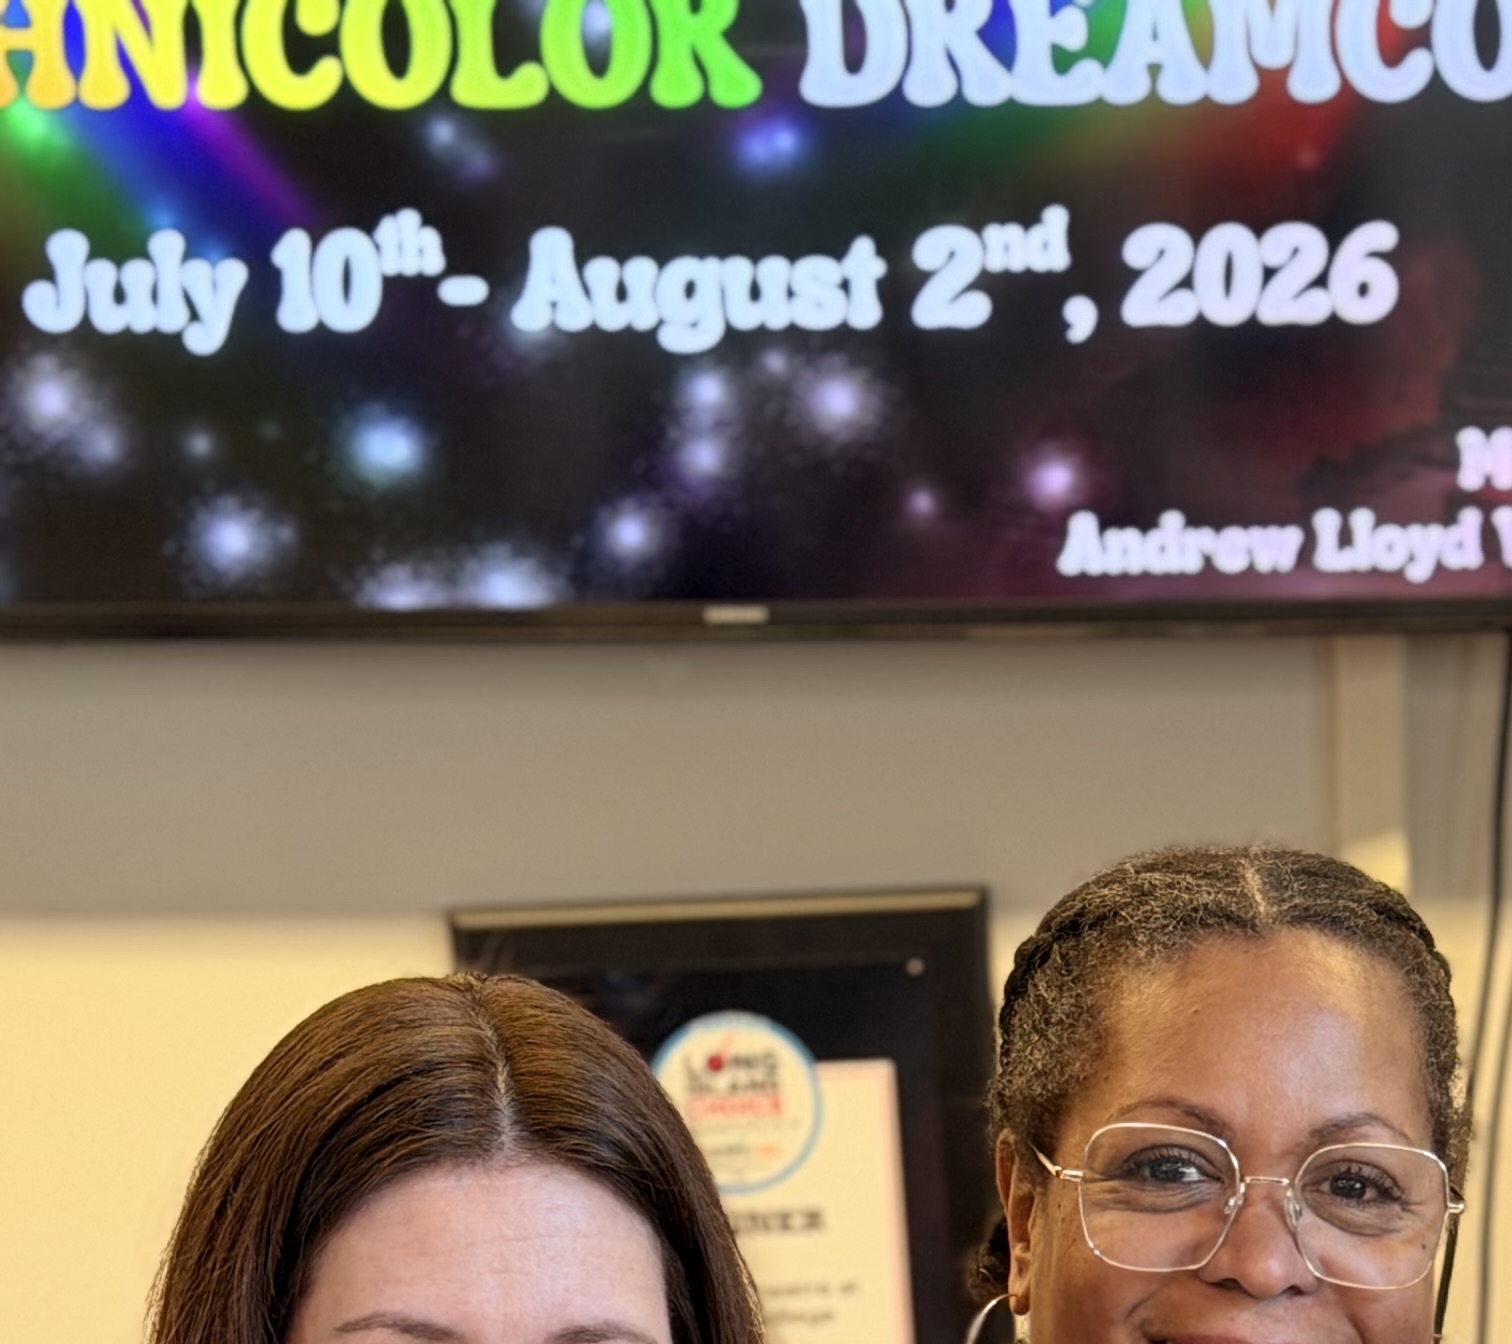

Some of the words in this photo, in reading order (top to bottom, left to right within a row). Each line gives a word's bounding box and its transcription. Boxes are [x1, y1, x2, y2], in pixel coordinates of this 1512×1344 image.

[22, 228, 249, 356] July
[510, 226, 887, 354] August
[1121, 220, 1399, 327] 2026
[1056, 508, 1304, 576] Andrew
[1311, 506, 1484, 584] Lloyd
